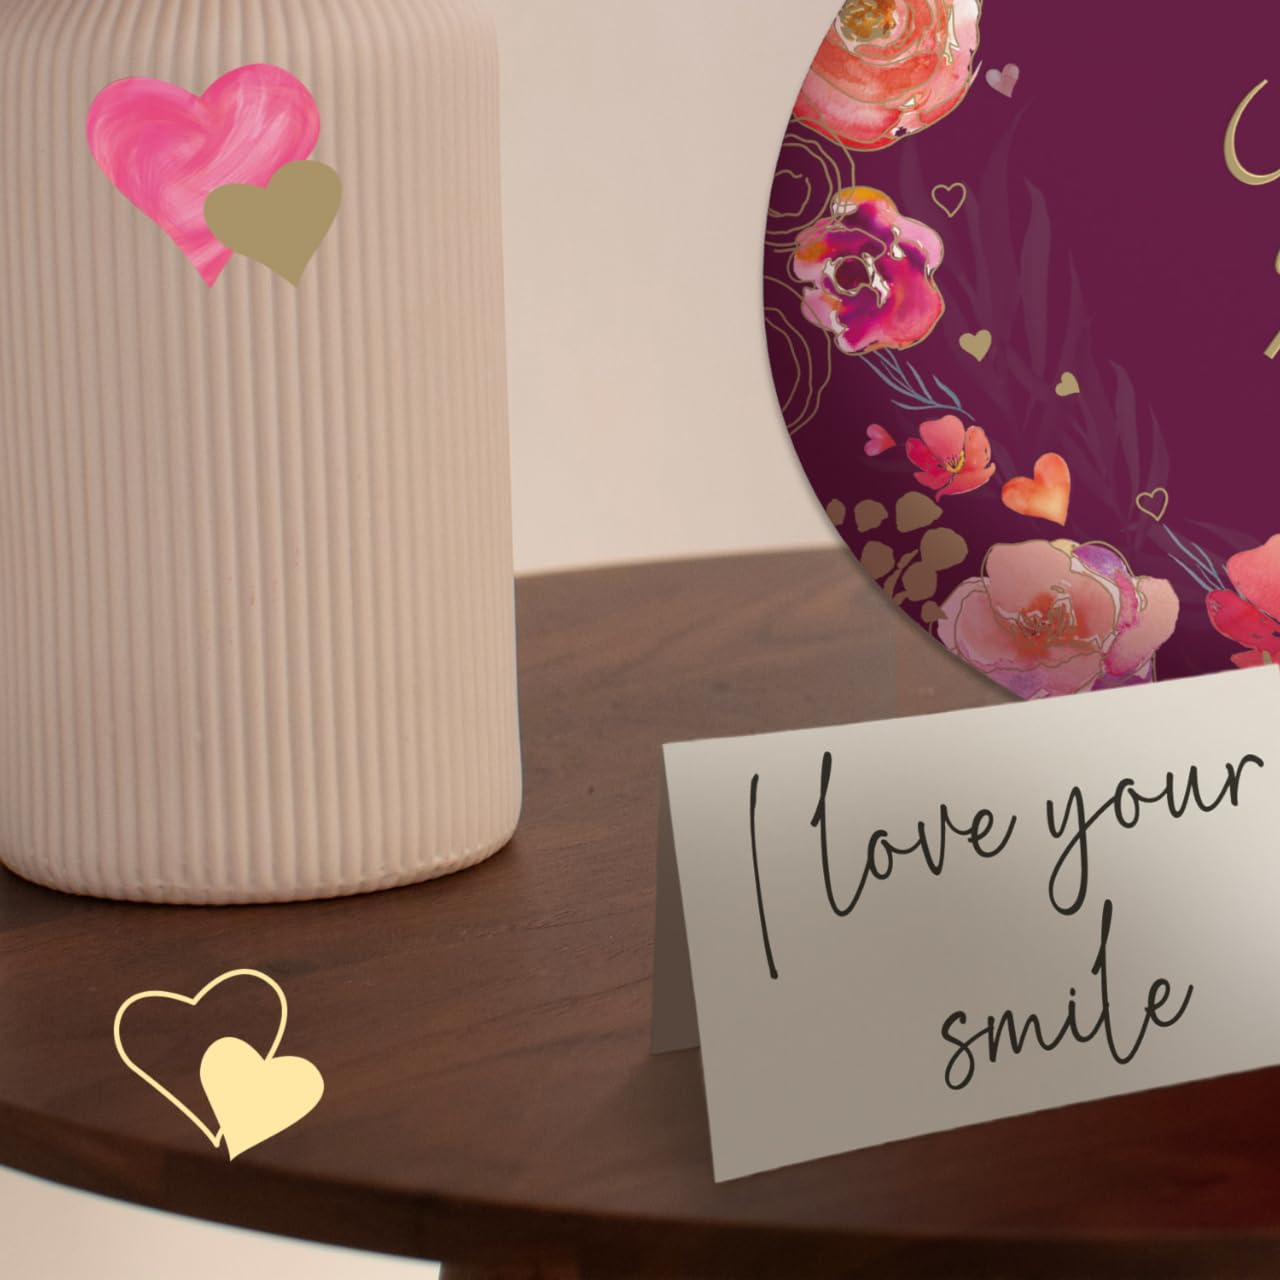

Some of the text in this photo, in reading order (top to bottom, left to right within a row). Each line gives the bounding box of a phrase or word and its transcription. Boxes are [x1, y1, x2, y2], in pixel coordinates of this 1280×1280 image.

[750, 751, 1265, 980] I love your
[941, 899, 1194, 1090] smile
